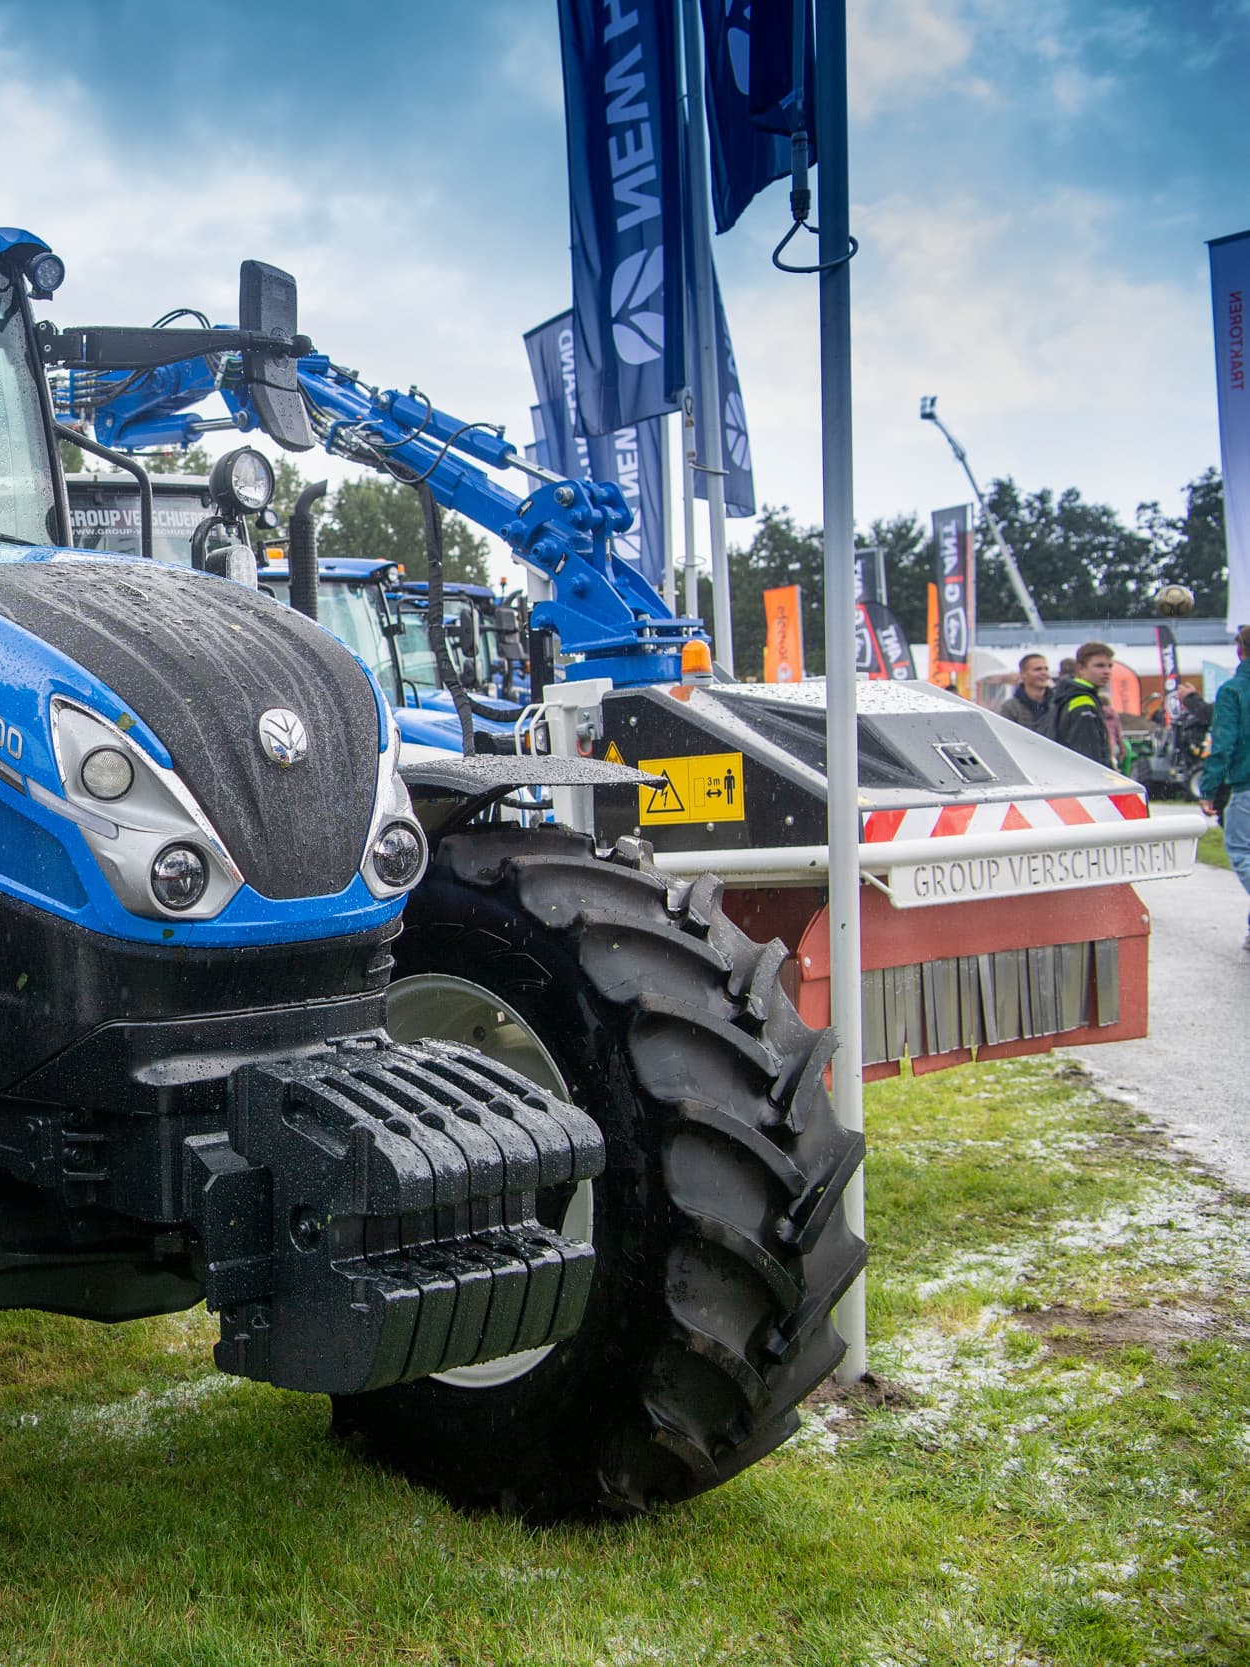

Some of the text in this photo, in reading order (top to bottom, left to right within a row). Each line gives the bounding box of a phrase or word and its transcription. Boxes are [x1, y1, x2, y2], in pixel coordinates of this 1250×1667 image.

[707, 776, 713, 787] 3
[913, 841, 1177, 897] GROUP VERSCHUEREN
